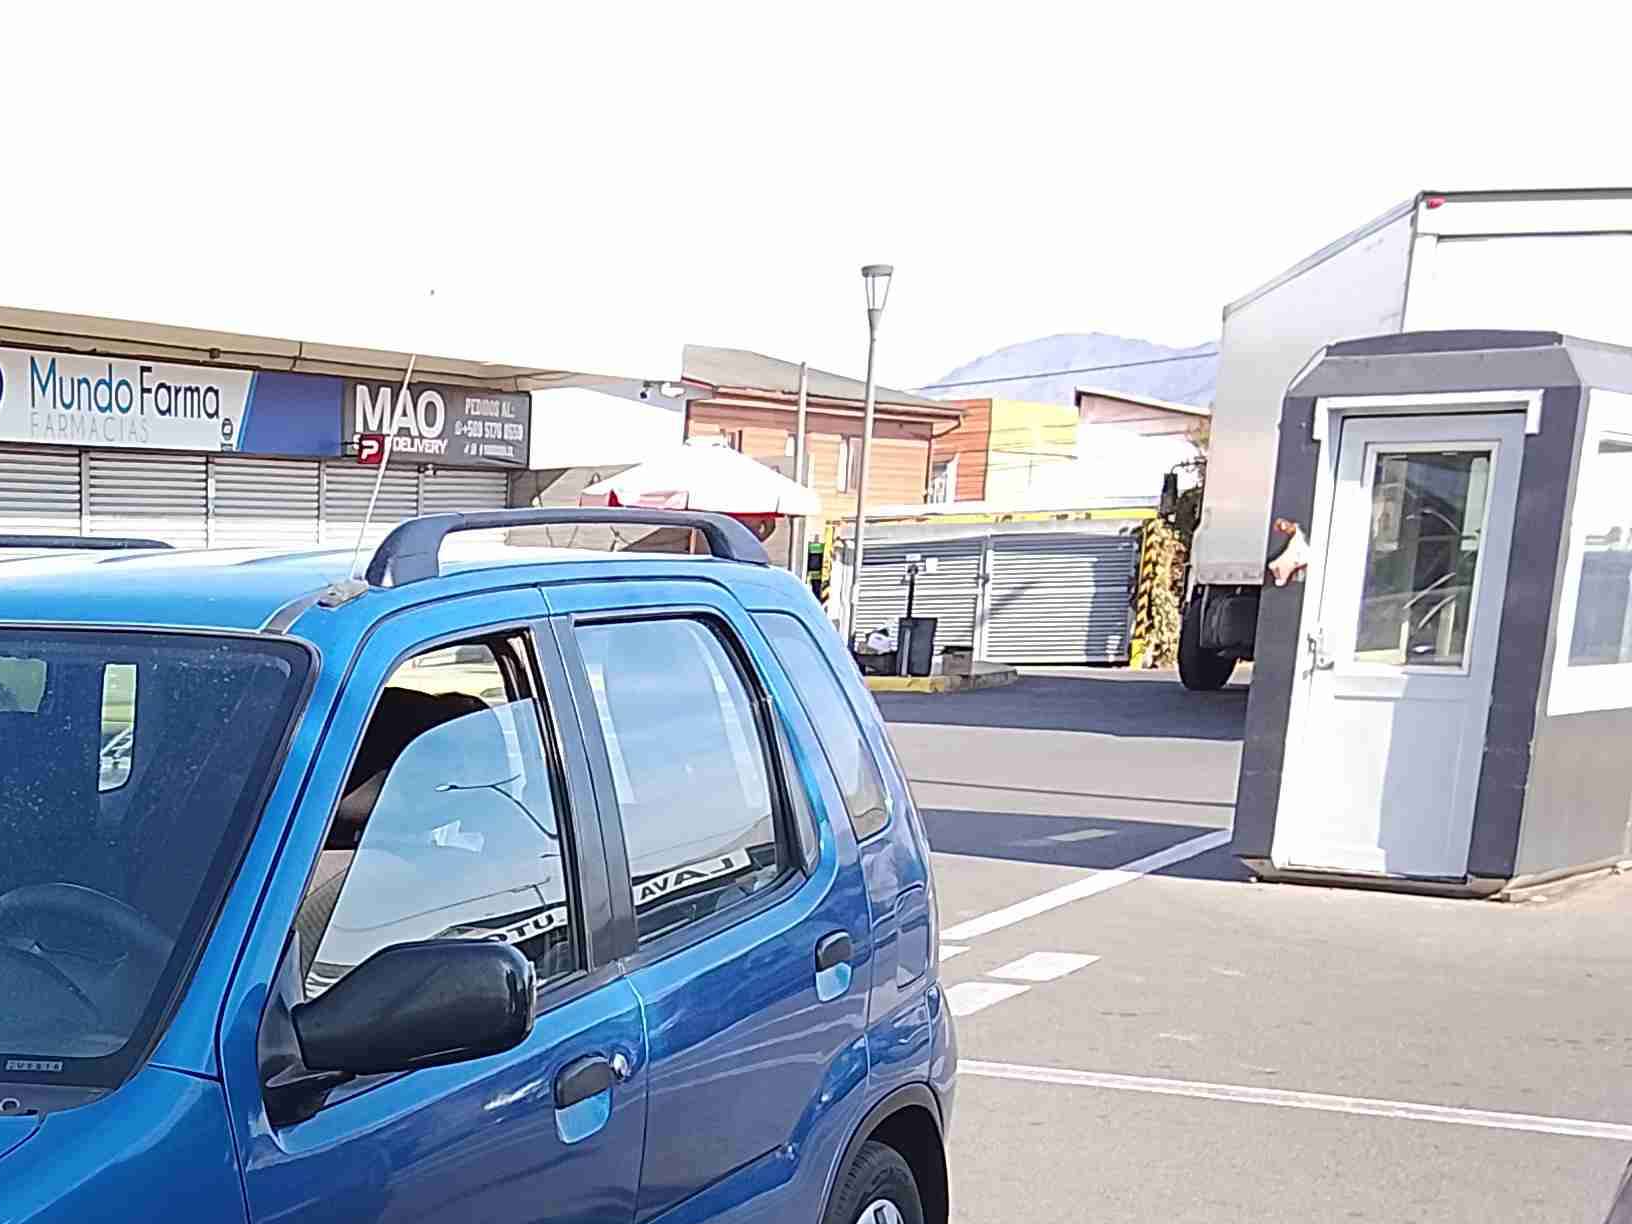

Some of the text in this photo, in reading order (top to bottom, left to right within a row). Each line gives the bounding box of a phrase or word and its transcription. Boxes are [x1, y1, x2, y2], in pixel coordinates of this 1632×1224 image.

[30, 356, 219, 419] Mundo Farma
[32, 411, 152, 443] FARMACIAS
[355, 384, 445, 438] MAO
[393, 436, 449, 455] DELIVERY
